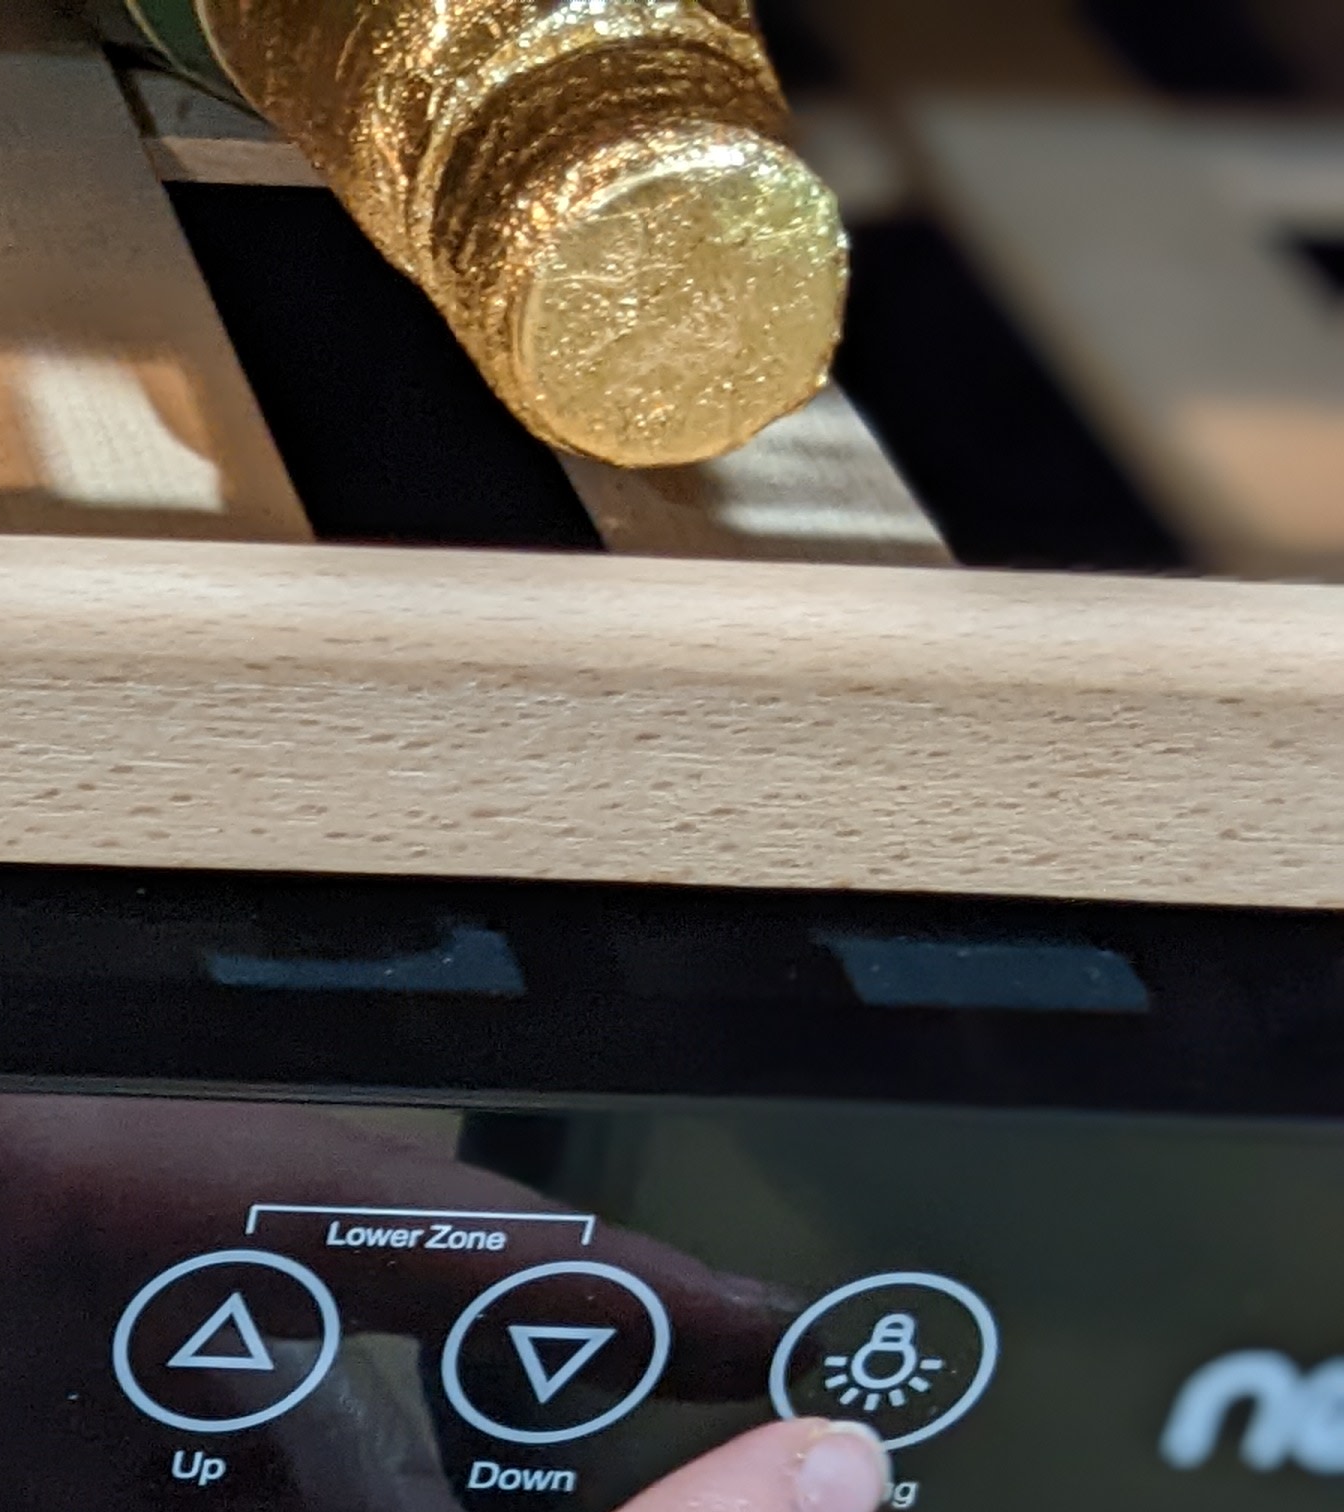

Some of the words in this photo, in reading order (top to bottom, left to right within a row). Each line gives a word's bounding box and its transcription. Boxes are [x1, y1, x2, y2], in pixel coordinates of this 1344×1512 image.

[327, 1221, 424, 1250] Lower
[424, 1224, 507, 1251] Zone
[171, 1449, 227, 1487] Up
[467, 1462, 576, 1492] Down
